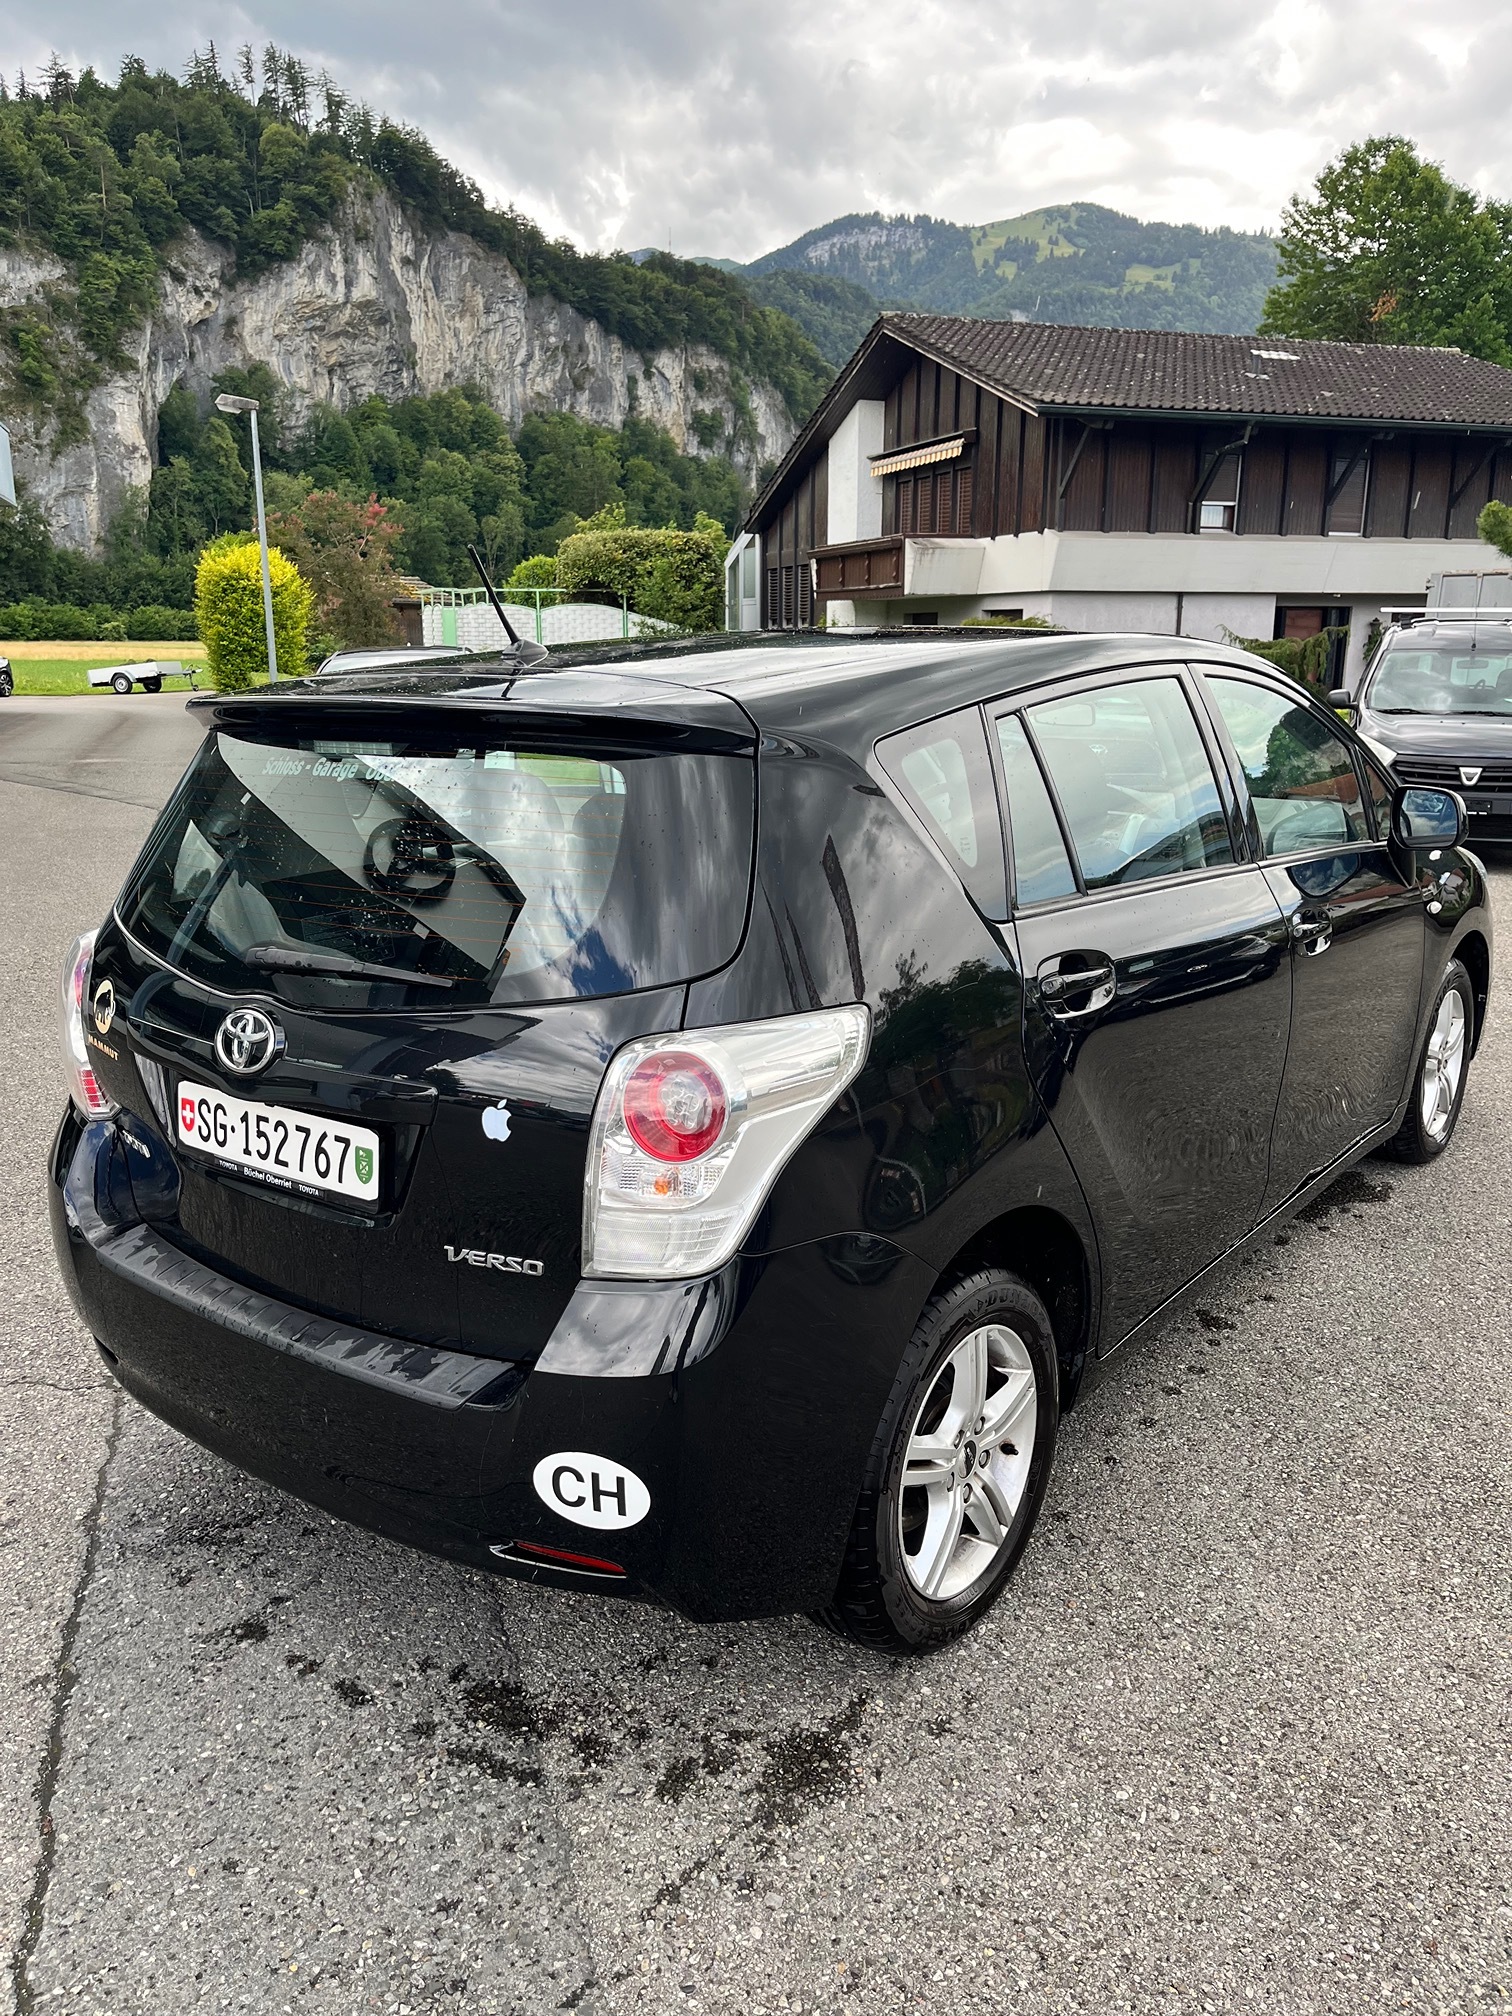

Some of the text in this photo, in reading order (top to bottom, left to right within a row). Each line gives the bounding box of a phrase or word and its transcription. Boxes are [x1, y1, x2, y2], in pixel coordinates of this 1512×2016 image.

[261, 756, 305, 776] Schloss
[312, 757, 359, 782] Garage
[88, 1034, 119, 1061] MAMMUT
[243, 1166, 265, 1181] Büchel
[265, 1173, 293, 1189] Oberriet
[298, 1184, 319, 1197] TOYOTA
[443, 1245, 545, 1277] VERSO
[551, 1465, 628, 1517] CH
